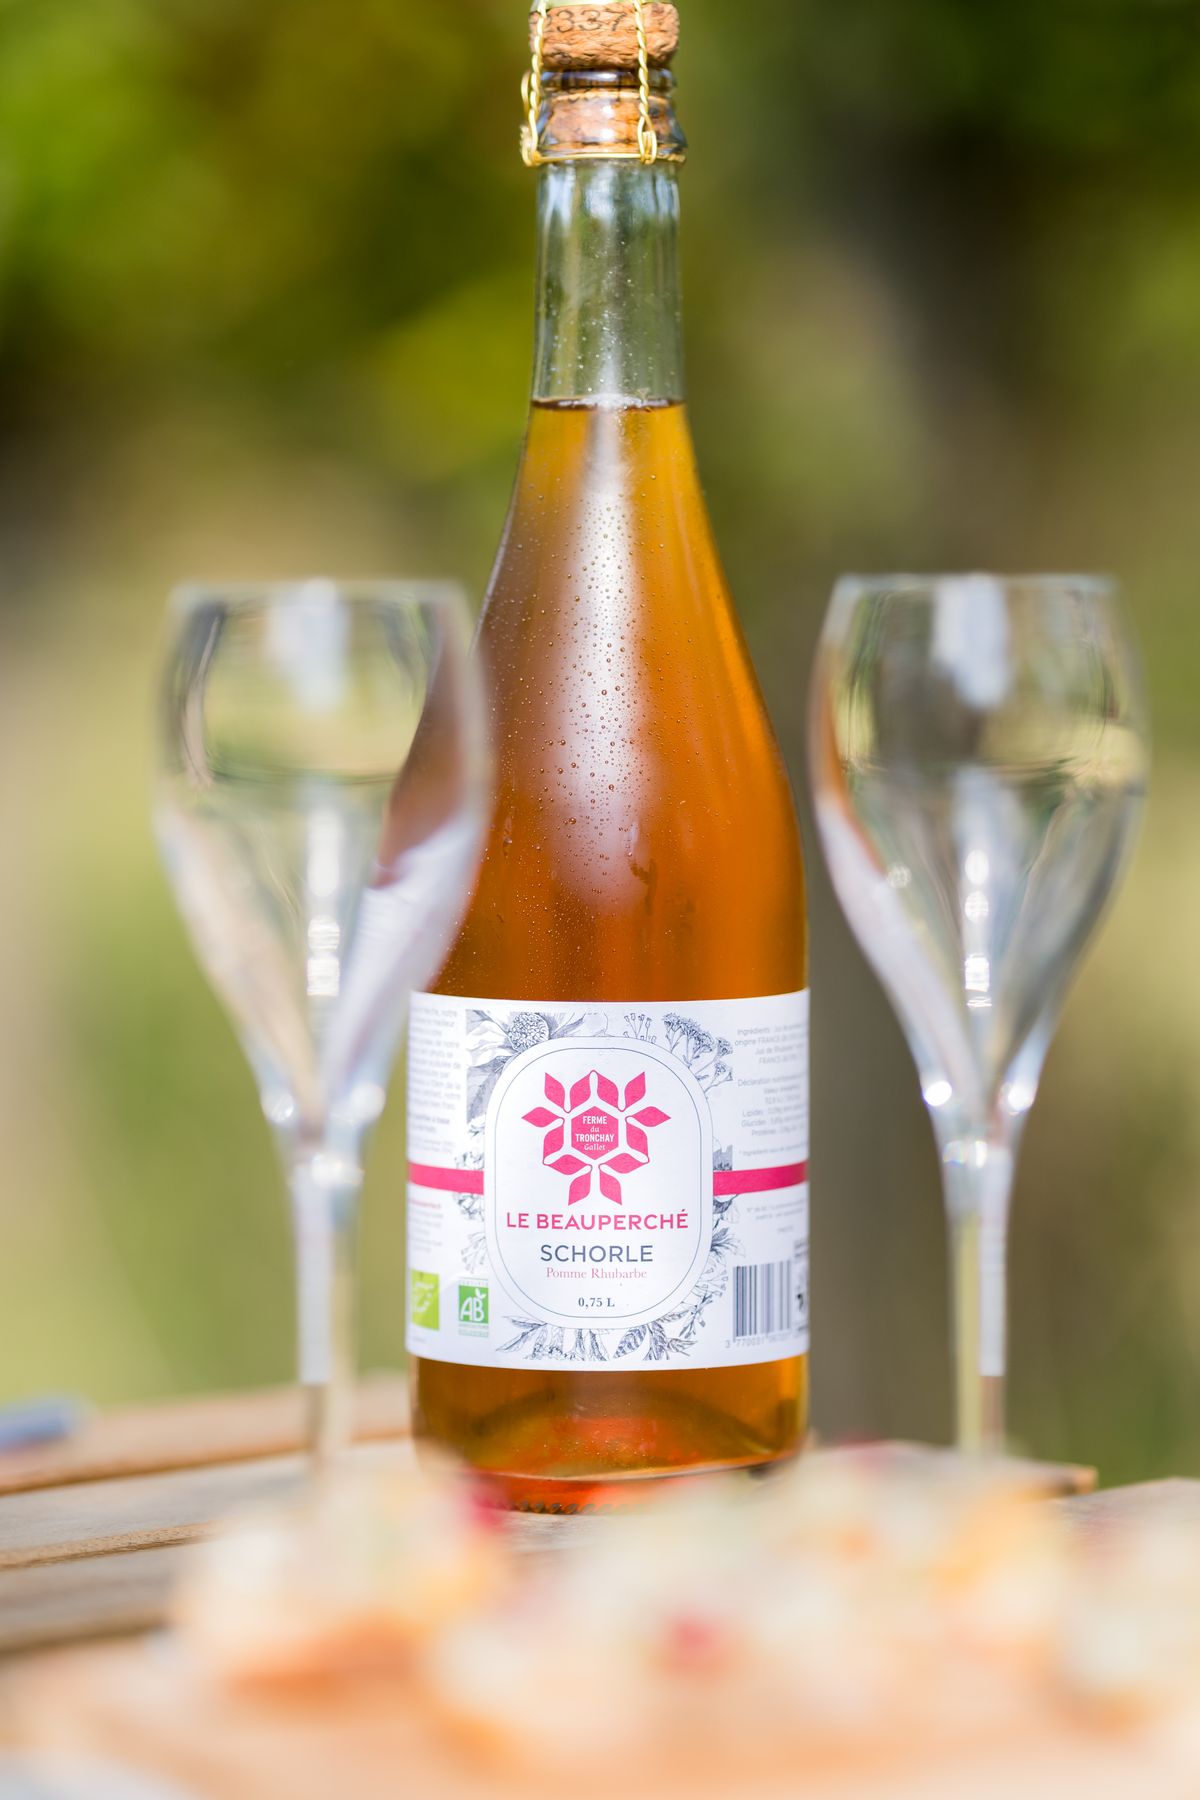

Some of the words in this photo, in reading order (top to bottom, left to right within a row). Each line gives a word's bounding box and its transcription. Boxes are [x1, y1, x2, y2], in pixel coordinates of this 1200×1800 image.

[582, 1115, 608, 1125] FERME
[590, 1125, 600, 1133] du
[575, 1133, 615, 1143] TRONCHAY
[506, 1212, 530, 1229] LE
[536, 1208, 689, 1230] BEAUPERCHÉ
[540, 1244, 654, 1263] SCHORLE
[546, 1267, 587, 1279] Pomme
[591, 1267, 647, 1280] Rhubarbe
[577, 1297, 603, 1310] 0,75
[606, 1297, 615, 1308] L
